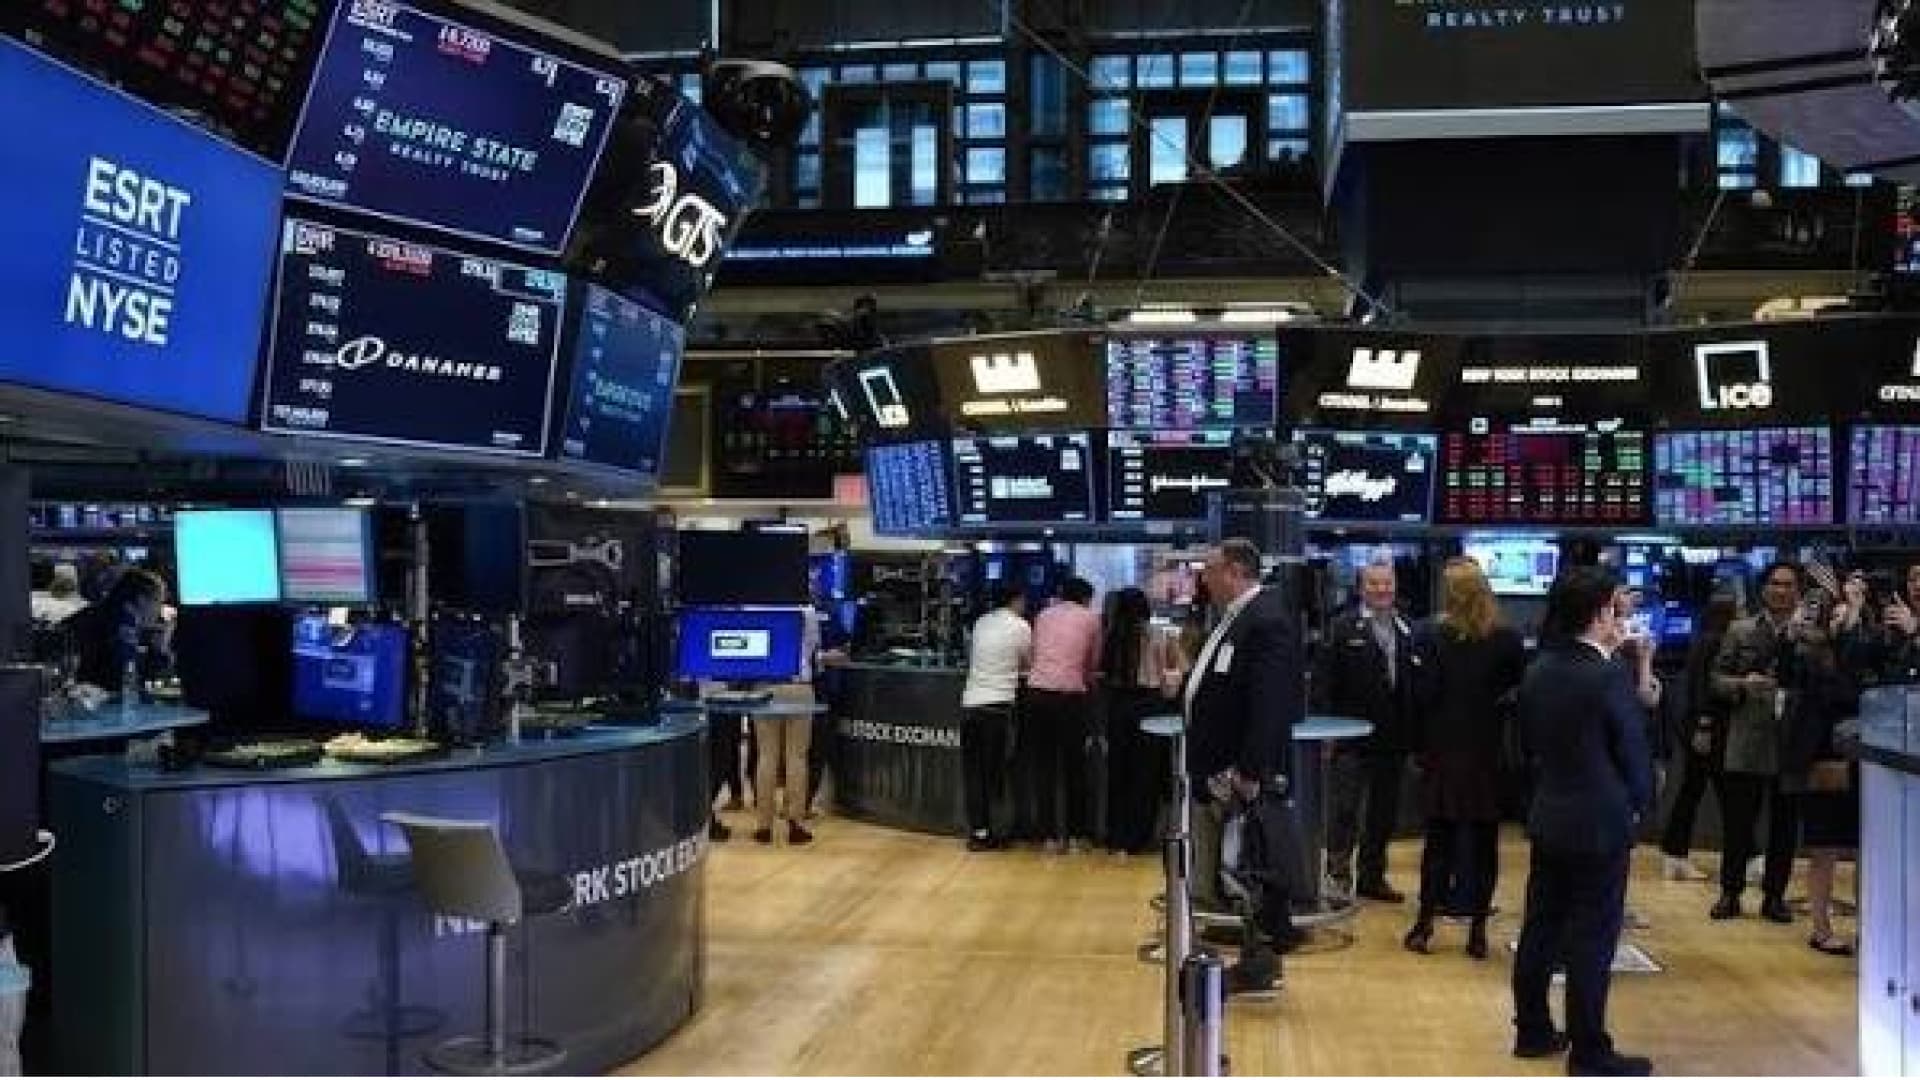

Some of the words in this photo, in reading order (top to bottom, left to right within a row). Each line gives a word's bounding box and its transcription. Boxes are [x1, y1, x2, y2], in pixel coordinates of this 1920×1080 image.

[1427, 9, 1526, 27] REALTY
[375, 110, 467, 153] EMPIRE
[471, 138, 539, 172] STATE
[85, 155, 191, 239] ESRT
[76, 226, 179, 285] LISTED
[64, 272, 173, 346] NYSE
